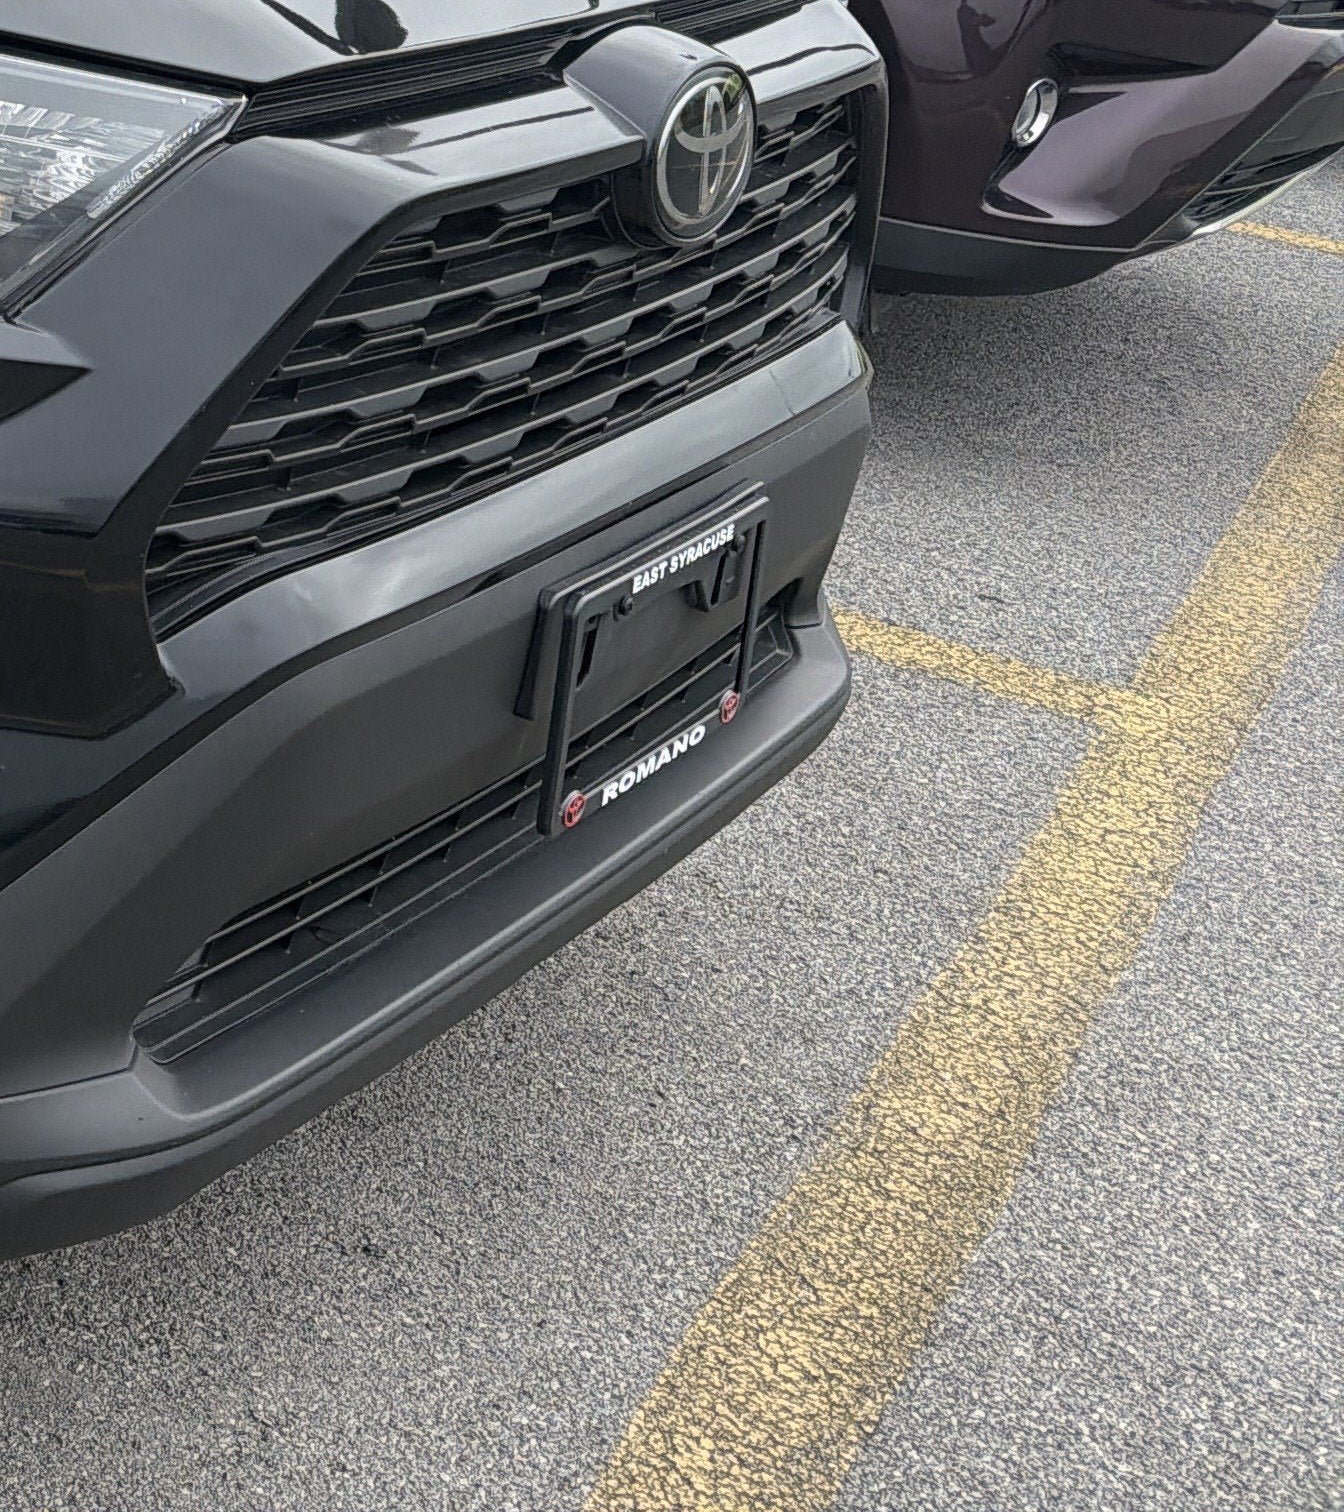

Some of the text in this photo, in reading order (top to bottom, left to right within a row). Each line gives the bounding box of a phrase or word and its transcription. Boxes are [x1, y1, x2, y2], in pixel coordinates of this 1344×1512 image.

[632, 523, 735, 594] EAST SYRACUSE
[601, 725, 706, 807] ROMANO
